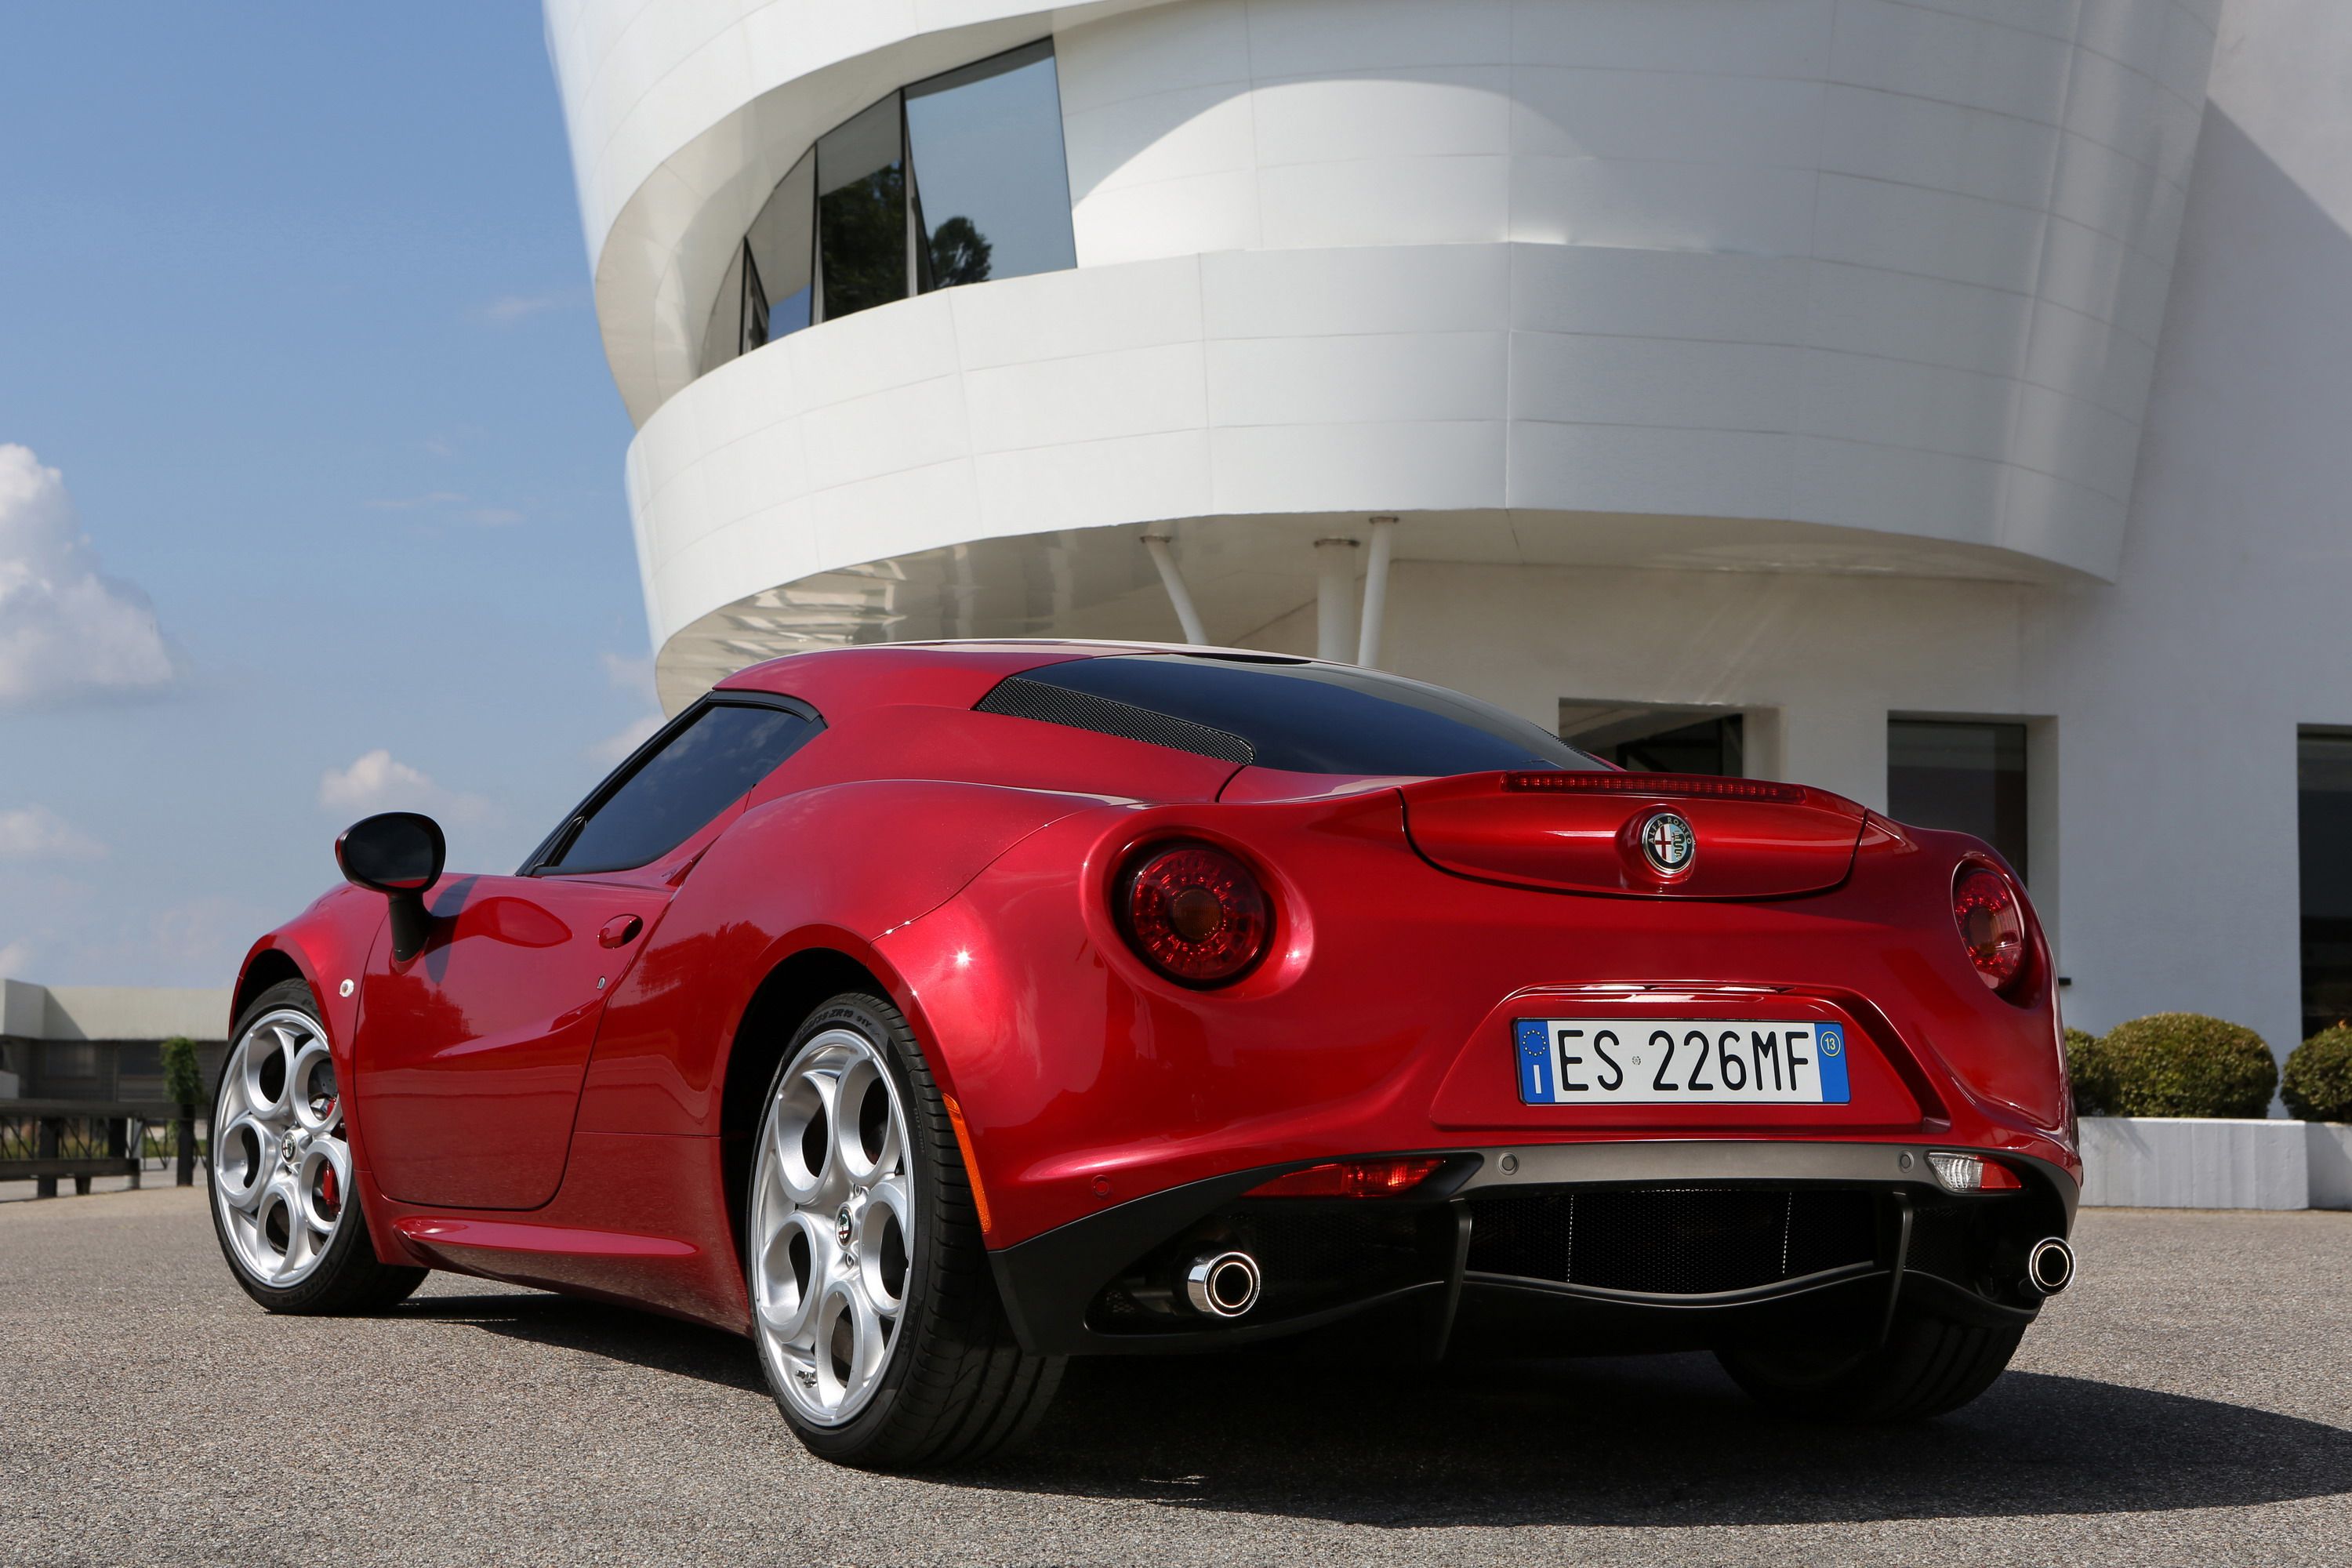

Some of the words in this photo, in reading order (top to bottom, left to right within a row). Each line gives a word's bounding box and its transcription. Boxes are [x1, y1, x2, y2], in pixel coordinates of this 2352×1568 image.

[1648, 819, 1663, 844] ALFA
[1668, 817, 1692, 844] ROMEO
[1824, 1037, 1836, 1051] 13
[1557, 1029, 1624, 1091] ES
[1648, 1029, 1809, 1091] 226MF
[1533, 1065, 1542, 1094] I
